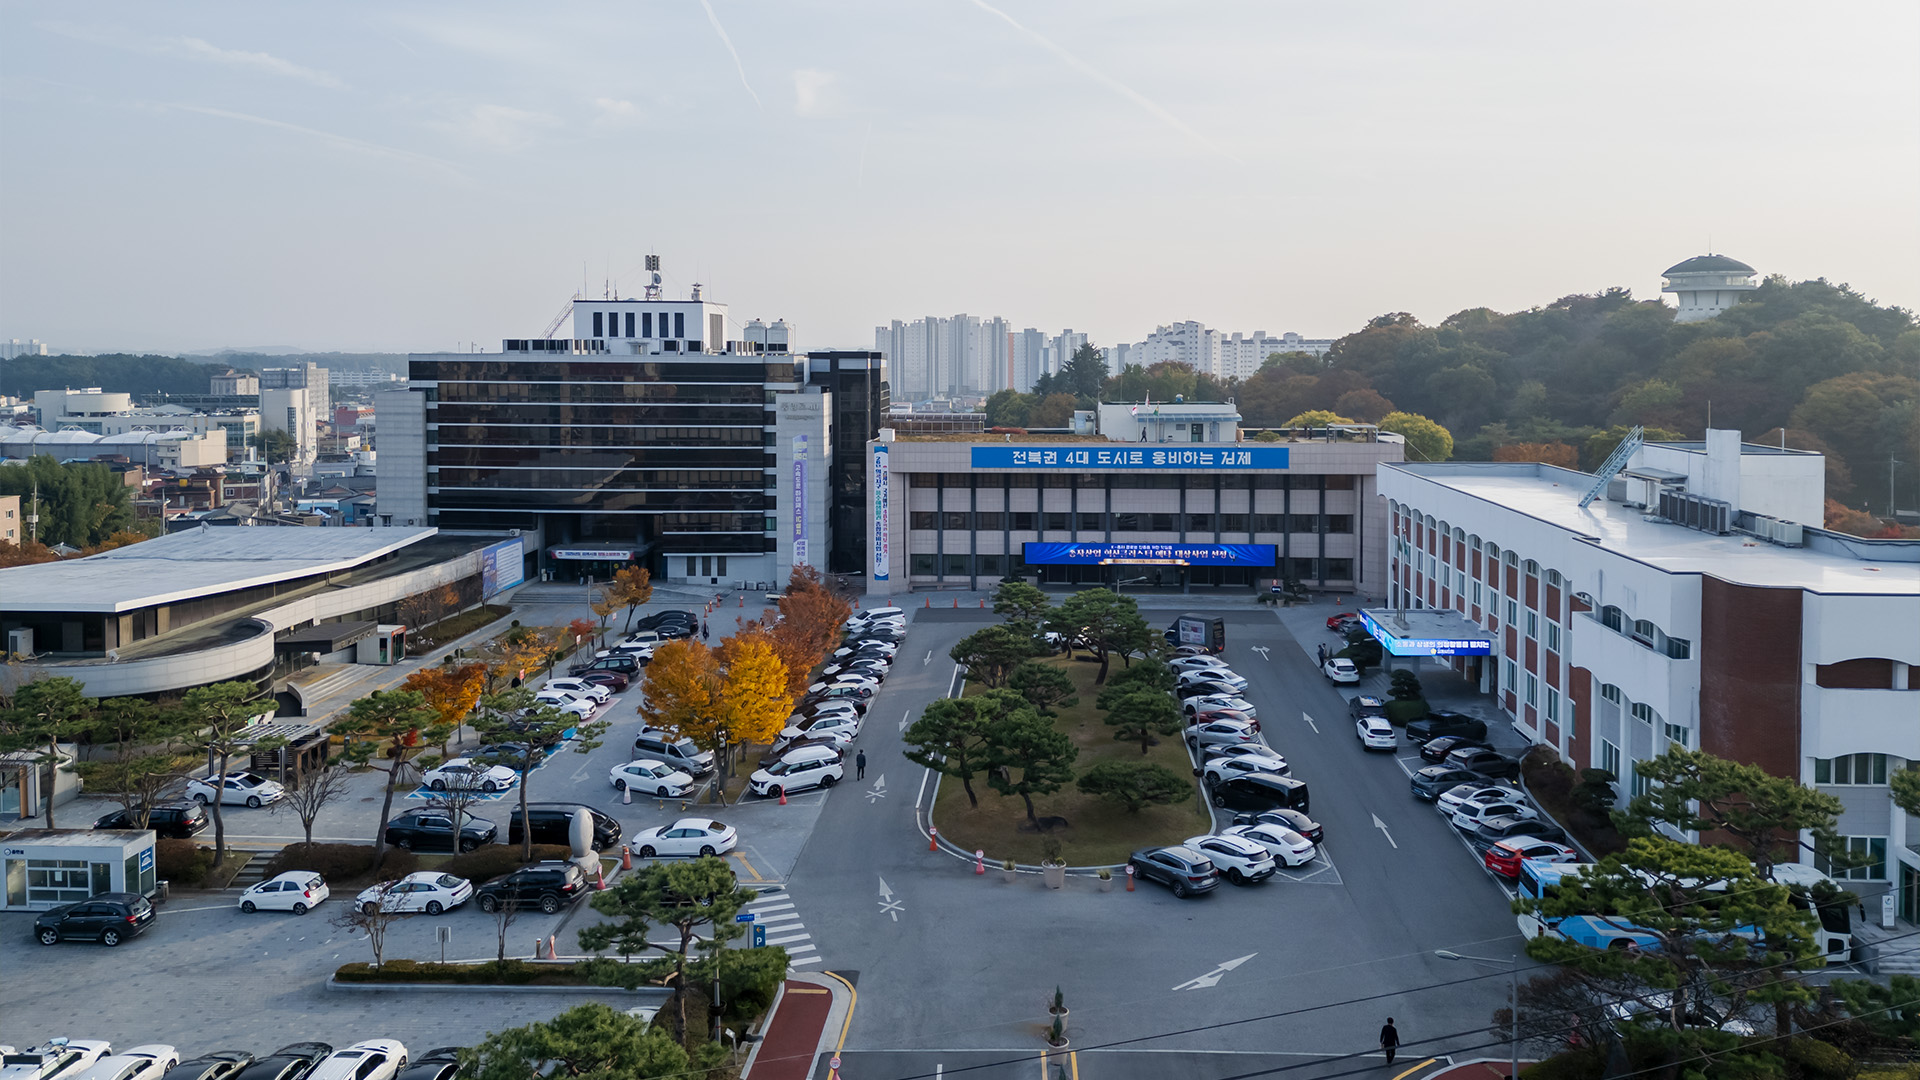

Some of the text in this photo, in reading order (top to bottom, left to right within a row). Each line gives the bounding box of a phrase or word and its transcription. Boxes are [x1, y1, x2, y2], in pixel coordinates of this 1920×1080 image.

[1013, 451, 1251, 465] 전북권 4대 도시로 웅비하는 김제
[1175, 550, 1209, 558] 대상사업
[756, 937, 762, 945] P
